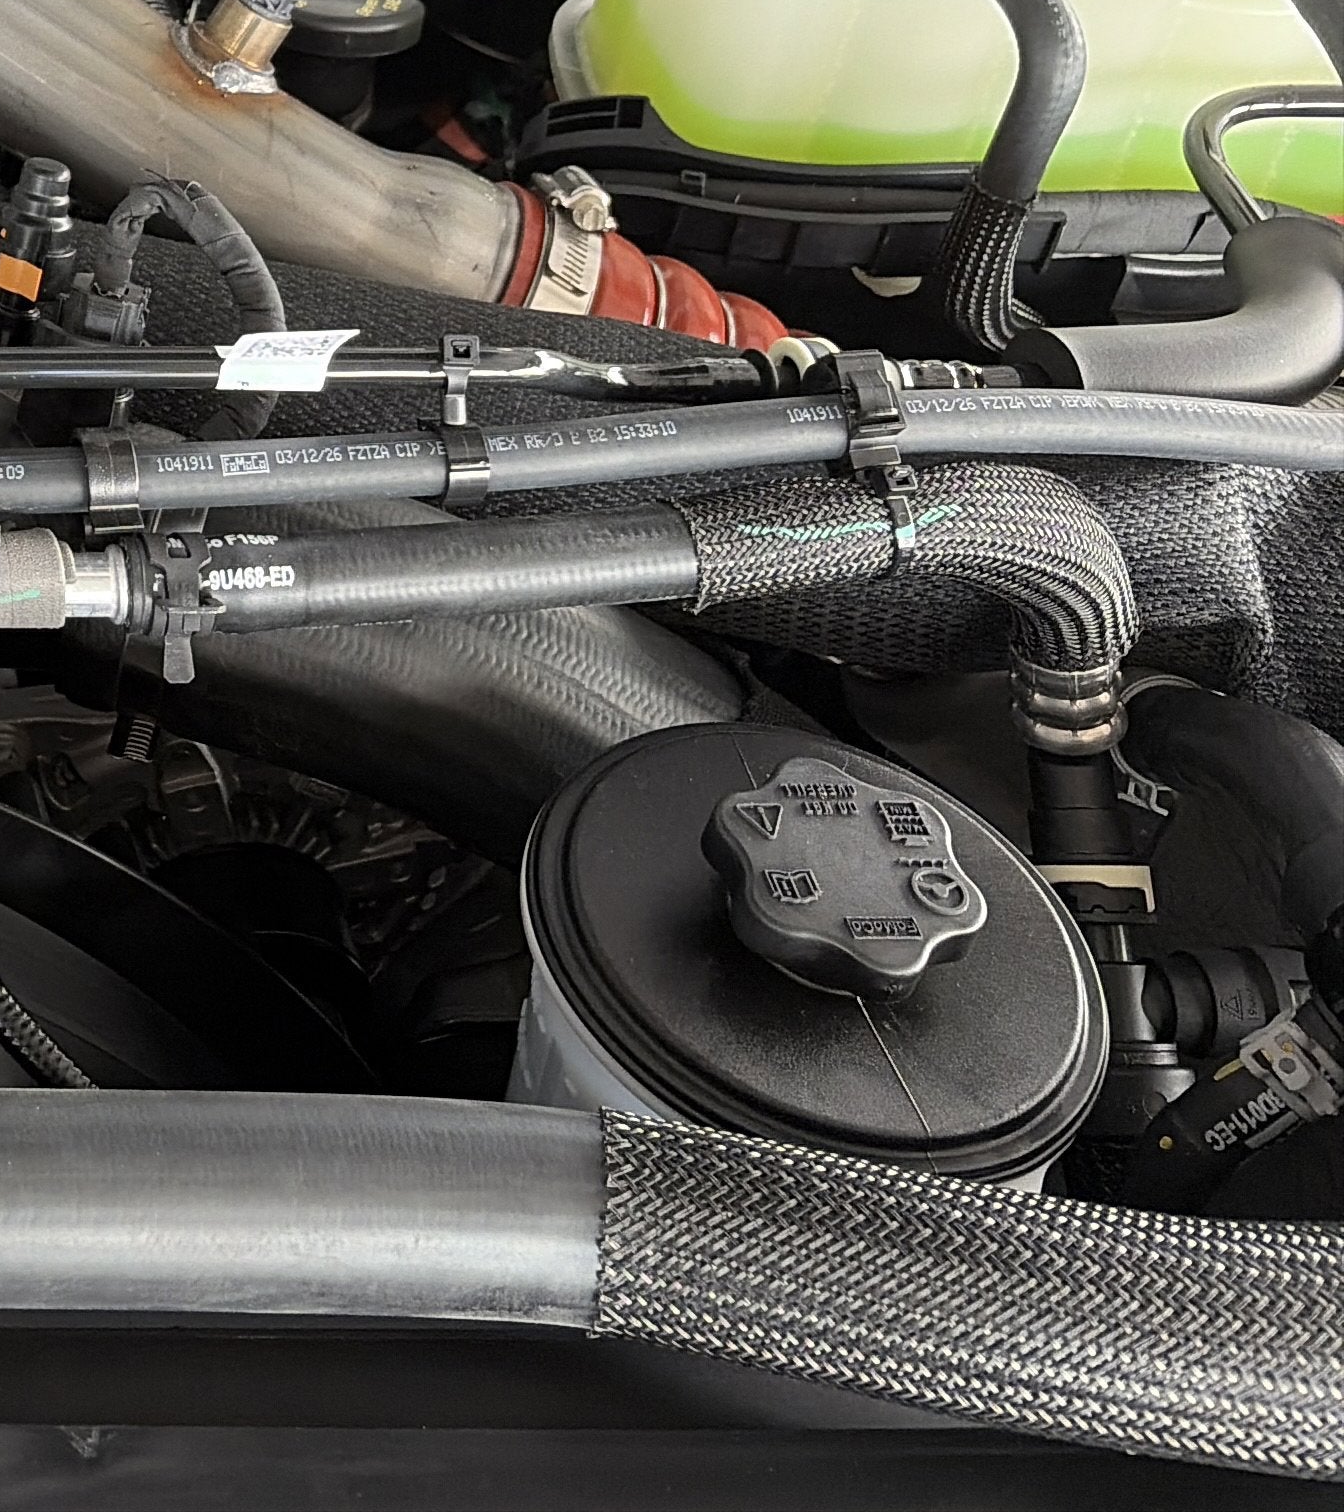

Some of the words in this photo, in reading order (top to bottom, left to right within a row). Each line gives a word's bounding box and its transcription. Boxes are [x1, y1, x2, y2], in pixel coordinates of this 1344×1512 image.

[157, 455, 214, 473] 1041911
[221, 454, 269, 475] FoMoCo
[275, 449, 342, 465] 03/12/26
[488, 436, 519, 452] MEX
[614, 420, 678, 441] 15:33:10
[849, 918, 920, 936] FoMoCo
